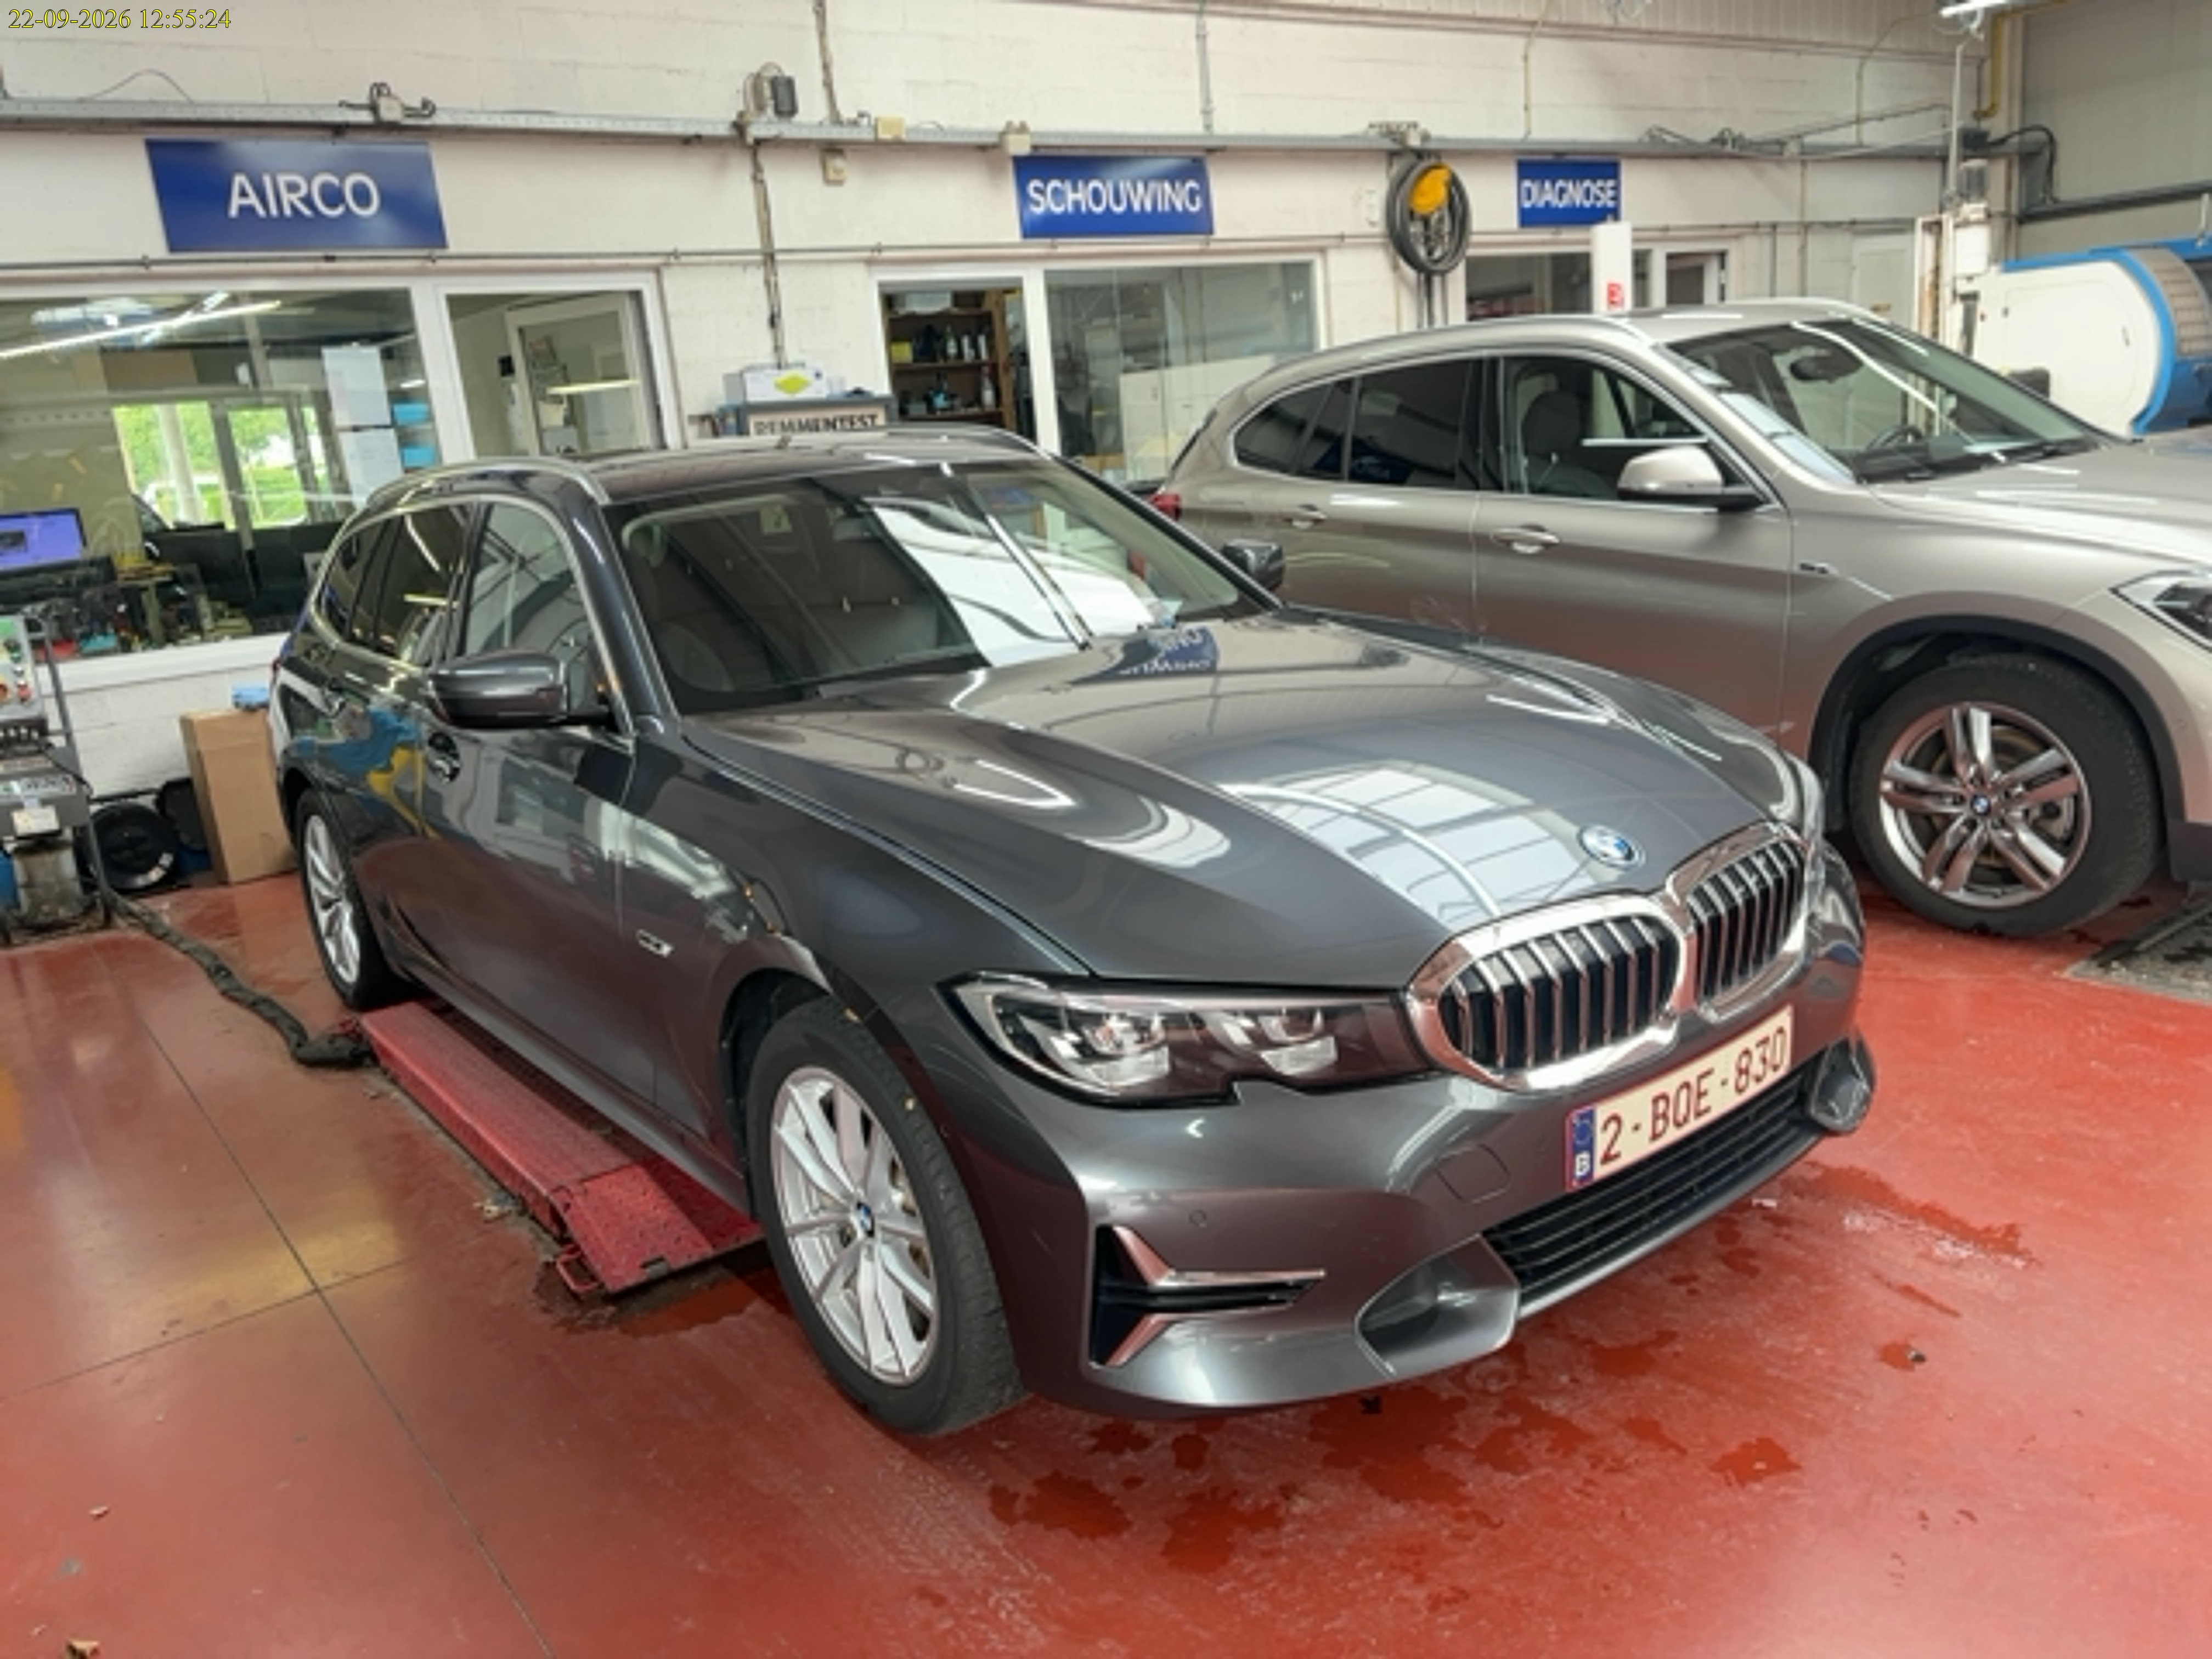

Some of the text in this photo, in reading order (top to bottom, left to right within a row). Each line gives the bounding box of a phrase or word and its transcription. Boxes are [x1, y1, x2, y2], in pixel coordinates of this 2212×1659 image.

[228, 173, 380, 217] AIRCO
[1028, 178, 1201, 215] SCHOUWING
[1521, 179, 1618, 208] DIAGNOSE
[1575, 1152, 1590, 1178] B
